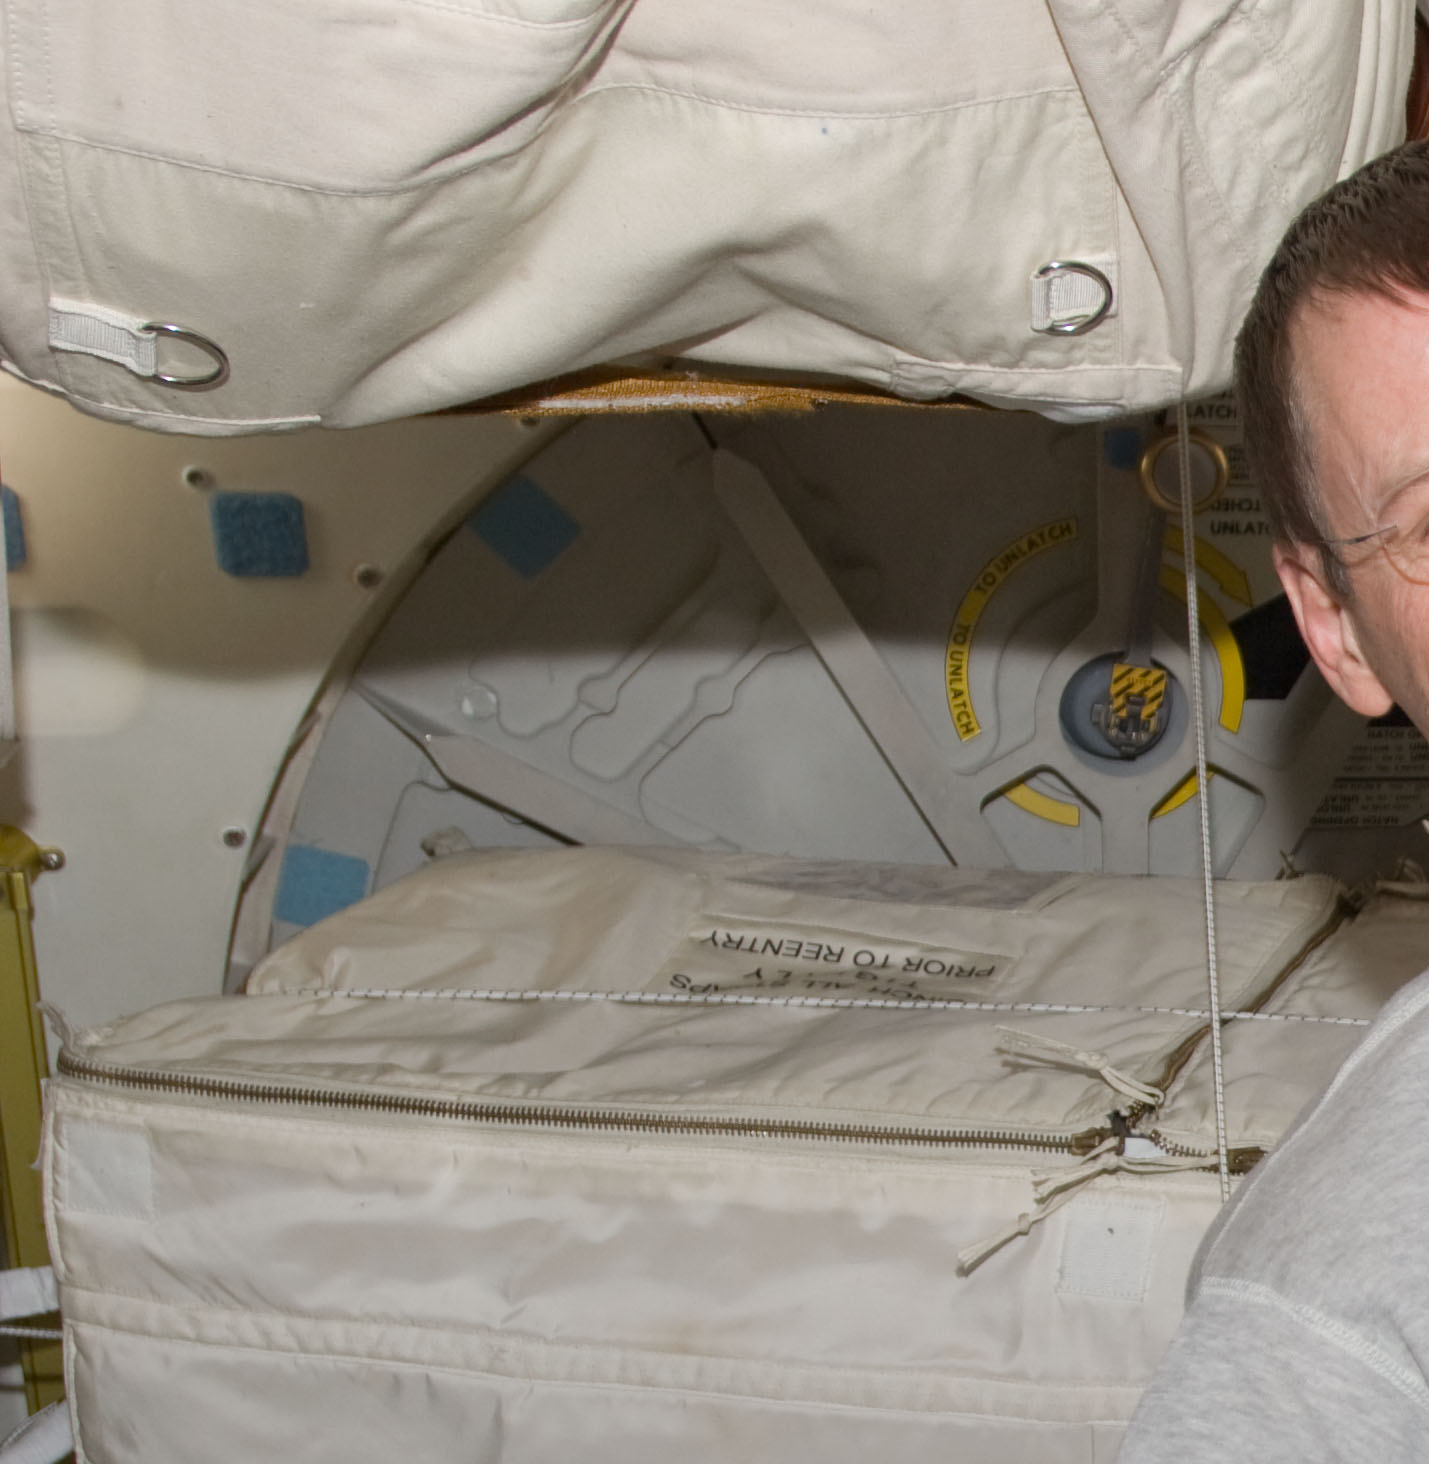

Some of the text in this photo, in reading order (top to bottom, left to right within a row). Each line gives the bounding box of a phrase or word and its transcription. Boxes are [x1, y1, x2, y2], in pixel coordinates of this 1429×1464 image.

[999, 521, 1072, 573] UNLATCH
[949, 623, 976, 736] TO UNLATCH
[699, 929, 997, 979] PRIOR TO REENTRY
